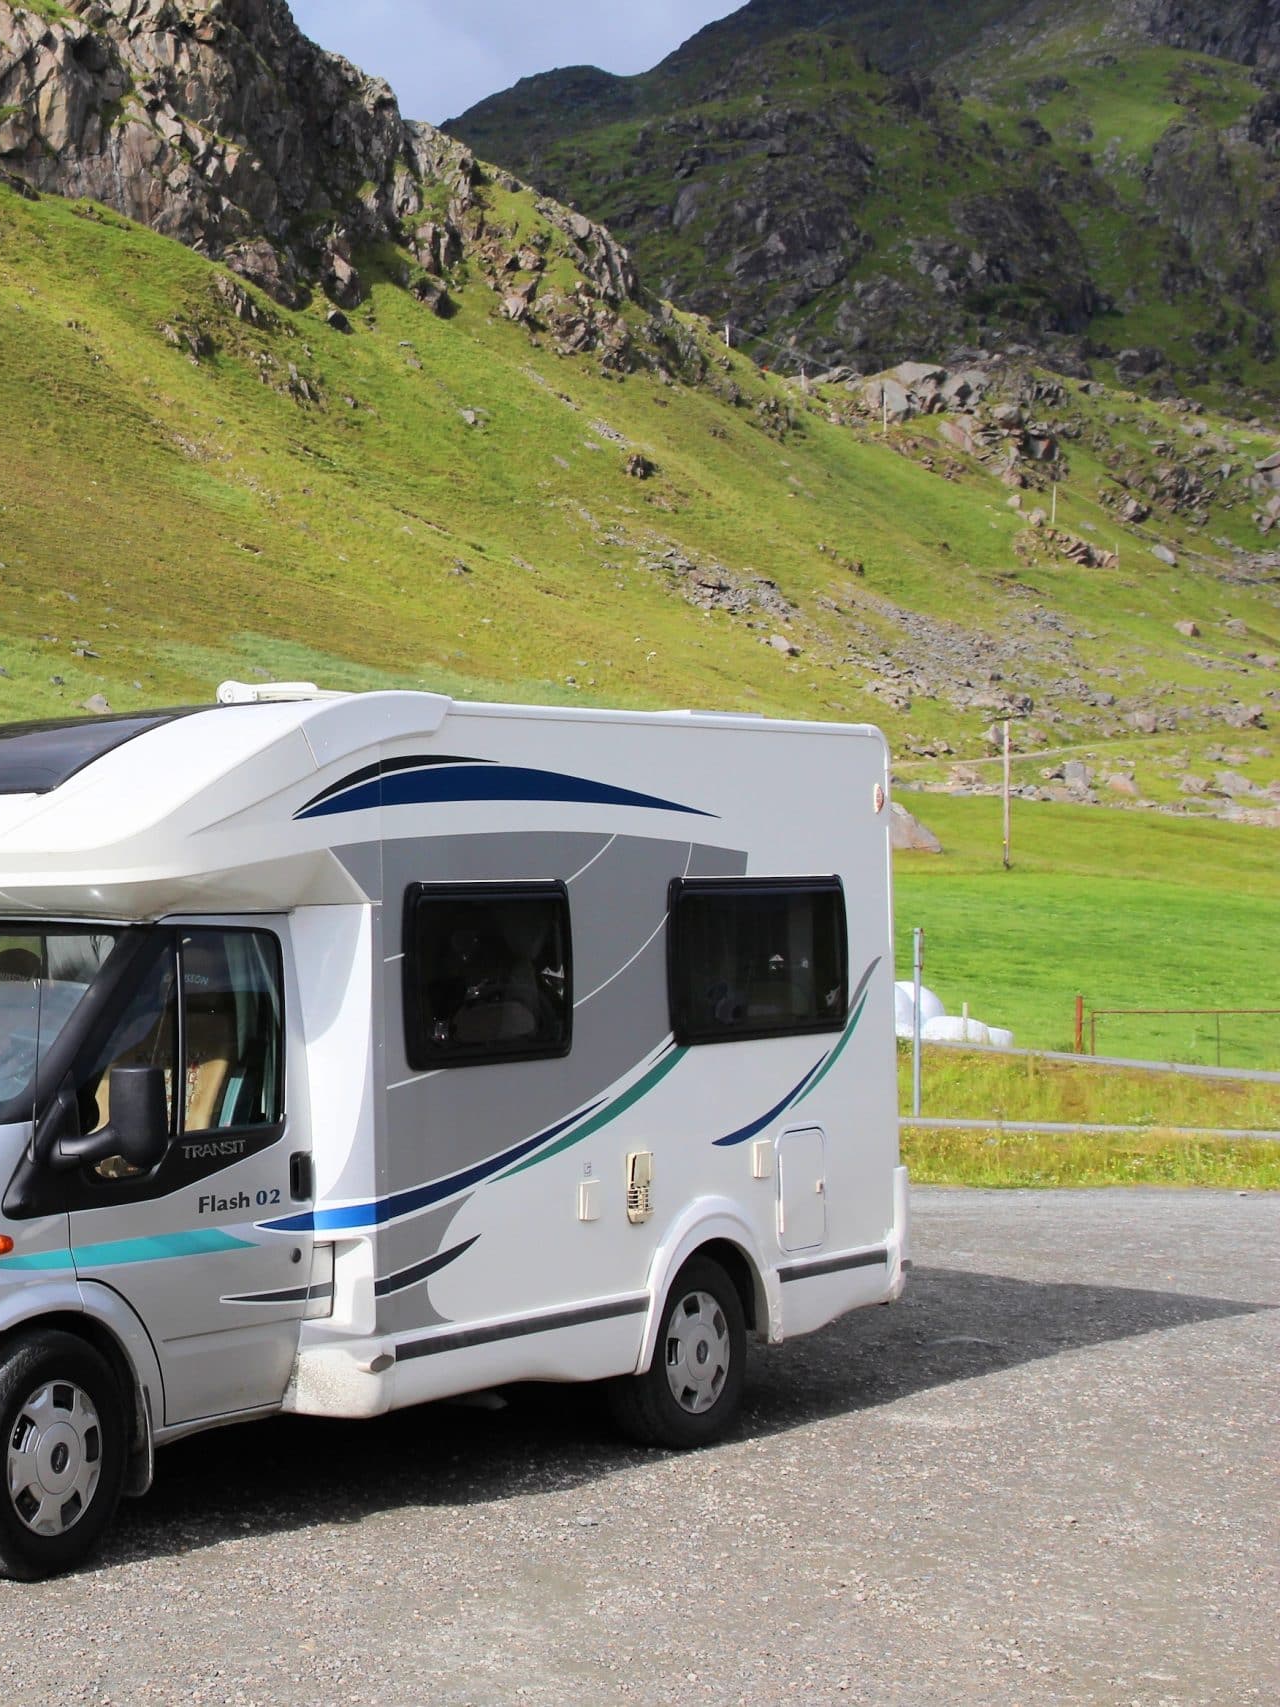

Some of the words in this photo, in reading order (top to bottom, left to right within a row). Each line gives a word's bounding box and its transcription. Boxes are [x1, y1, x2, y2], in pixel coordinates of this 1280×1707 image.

[182, 1139, 246, 1159] TRANSIT
[198, 1191, 250, 1214] Flash
[256, 1188, 281, 1206] 02
